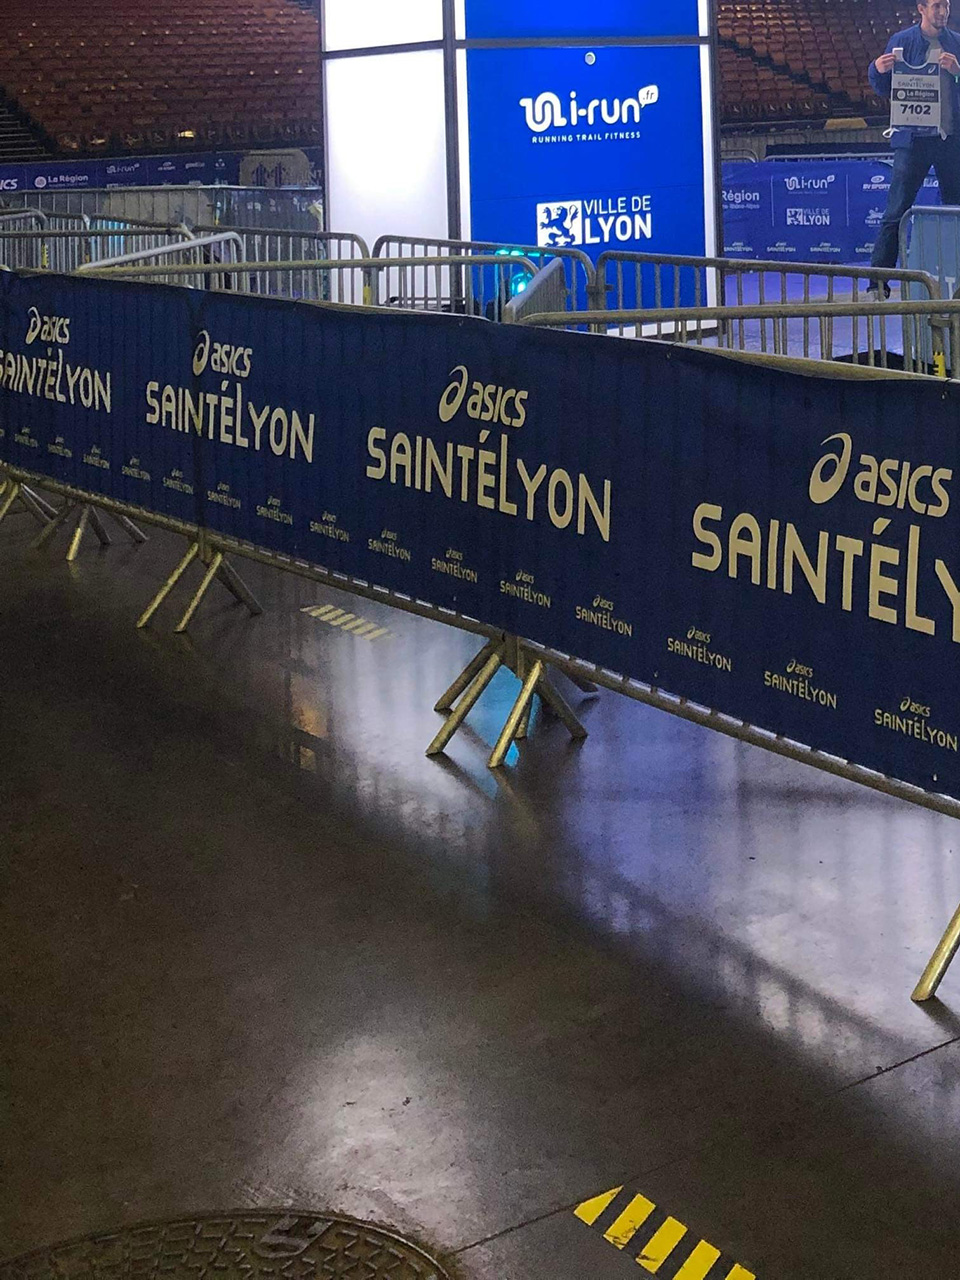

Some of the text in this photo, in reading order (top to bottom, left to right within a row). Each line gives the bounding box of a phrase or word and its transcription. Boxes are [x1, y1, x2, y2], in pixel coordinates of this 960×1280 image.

[570, 90, 640, 126] i-run
[900, 104, 931, 115] 7102
[532, 131, 641, 144] RUNNING TRAIL FITNESS
[801, 176, 828, 189] i-run
[584, 195, 652, 216] VILLE DE
[584, 213, 653, 245] LYON
[804, 215, 830, 225] LYON
[41, 316, 69, 343] asics
[211, 343, 252, 377] asics
[467, 382, 528, 427] asics
[147, 380, 314, 463] SAINTÉLYON
[367, 427, 610, 541] SAINTÉLYON
[854, 455, 952, 517] asics
[367, 538, 412, 562] SAINTÉLYON
[431, 558, 478, 584] SAINTÉLYON
[500, 580, 551, 608] SAINTÉLYON
[575, 606, 633, 637] SAINTÉLYON
[695, 631, 710, 643] asics
[668, 638, 731, 671] SAINTÉLYON
[795, 664, 813, 677] asics
[765, 671, 836, 708] SAINTÉLYON
[910, 702, 930, 720] asics
[874, 708, 959, 753] SAINTÉLYON
